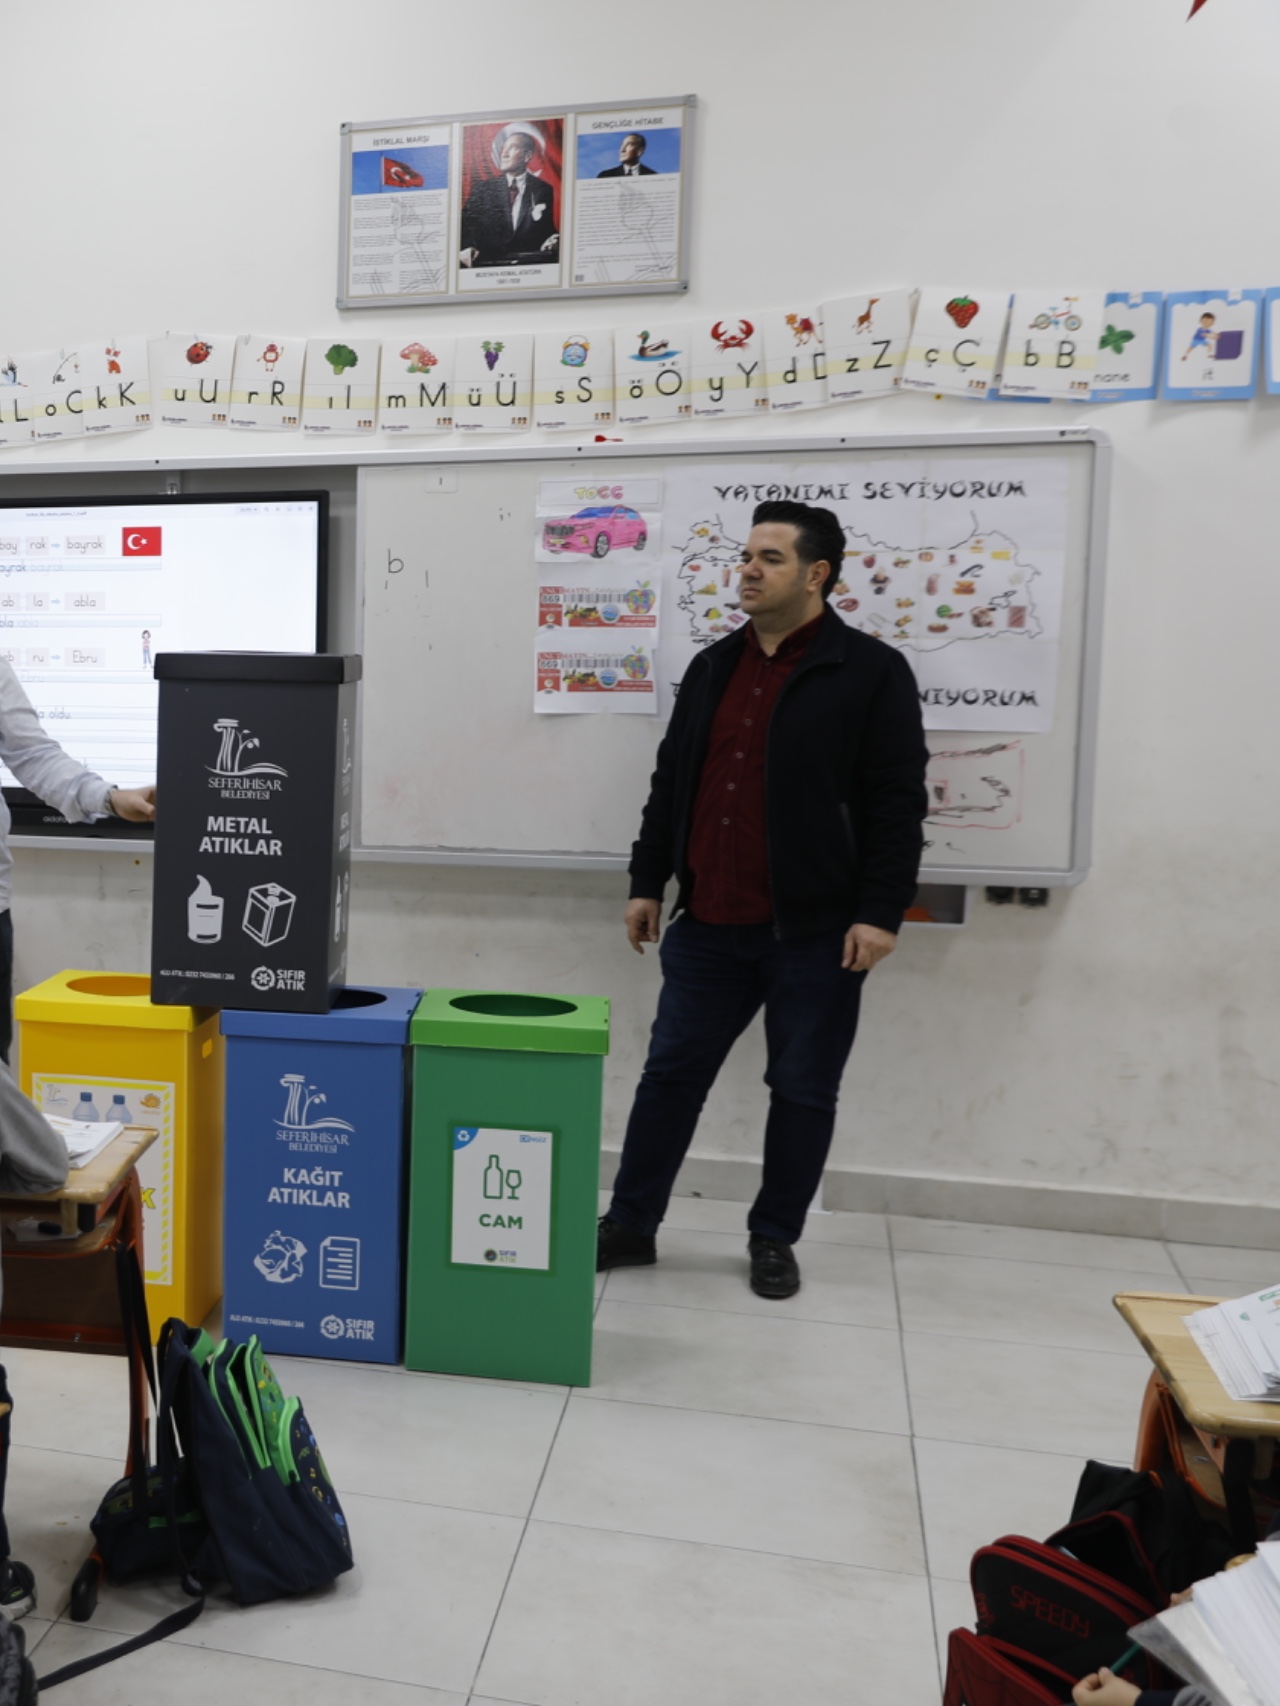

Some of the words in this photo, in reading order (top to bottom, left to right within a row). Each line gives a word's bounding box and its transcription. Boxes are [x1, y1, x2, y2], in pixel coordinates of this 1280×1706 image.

[845, 357, 859, 373] z
[871, 340, 892, 369] Z
[925, 348, 939, 367] ç
[1024, 339, 1039, 366] b
[1056, 340, 1075, 368] B
[629, 379, 643, 398] ö
[655, 362, 682, 396] Ö
[783, 357, 796, 384] d
[174, 389, 186, 401] u
[199, 379, 218, 404] U
[468, 388, 481, 407] ü
[496, 373, 517, 407] Ü
[554, 390, 565, 404] s
[577, 376, 592, 403] S
[708, 377, 724, 402] y
[737, 361, 758, 388] Y
[97, 386, 108, 409] k
[119, 382, 136, 407] K
[248, 391, 259, 404] r
[270, 380, 285, 405] R
[388, 394, 406, 408] m
[420, 382, 446, 408] M
[14, 398, 29, 422] L
[45, 404, 57, 416] o
[30, 537, 47, 549] rak
[66, 537, 103, 554] bayrak
[388, 548, 404, 573] b
[1, 595, 15, 607] ab
[33, 595, 43, 607] la
[73, 595, 97, 607] abla
[33, 653, 45, 663] ru
[72, 650, 98, 663] Ebru
[208, 776, 283, 791] SEFERİHİSAR
[221, 789, 271, 800] BELEDİYESİ
[207, 816, 273, 834] METAL
[199, 836, 283, 857] ATIKLAR
[276, 969, 306, 980] SIFIR
[276, 979, 306, 991] ATIK
[276, 1130, 350, 1146] SEFERİHİSAR
[289, 1142, 338, 1154] BELEDİYESİ
[283, 1166, 343, 1187] KAĞIT
[267, 1187, 350, 1208] ATIKLAR
[478, 1213, 523, 1230] CAM
[345, 1319, 375, 1330] SIFIR
[345, 1329, 375, 1340] ATIK
[1011, 1585, 1089, 1638] SPEEDY
